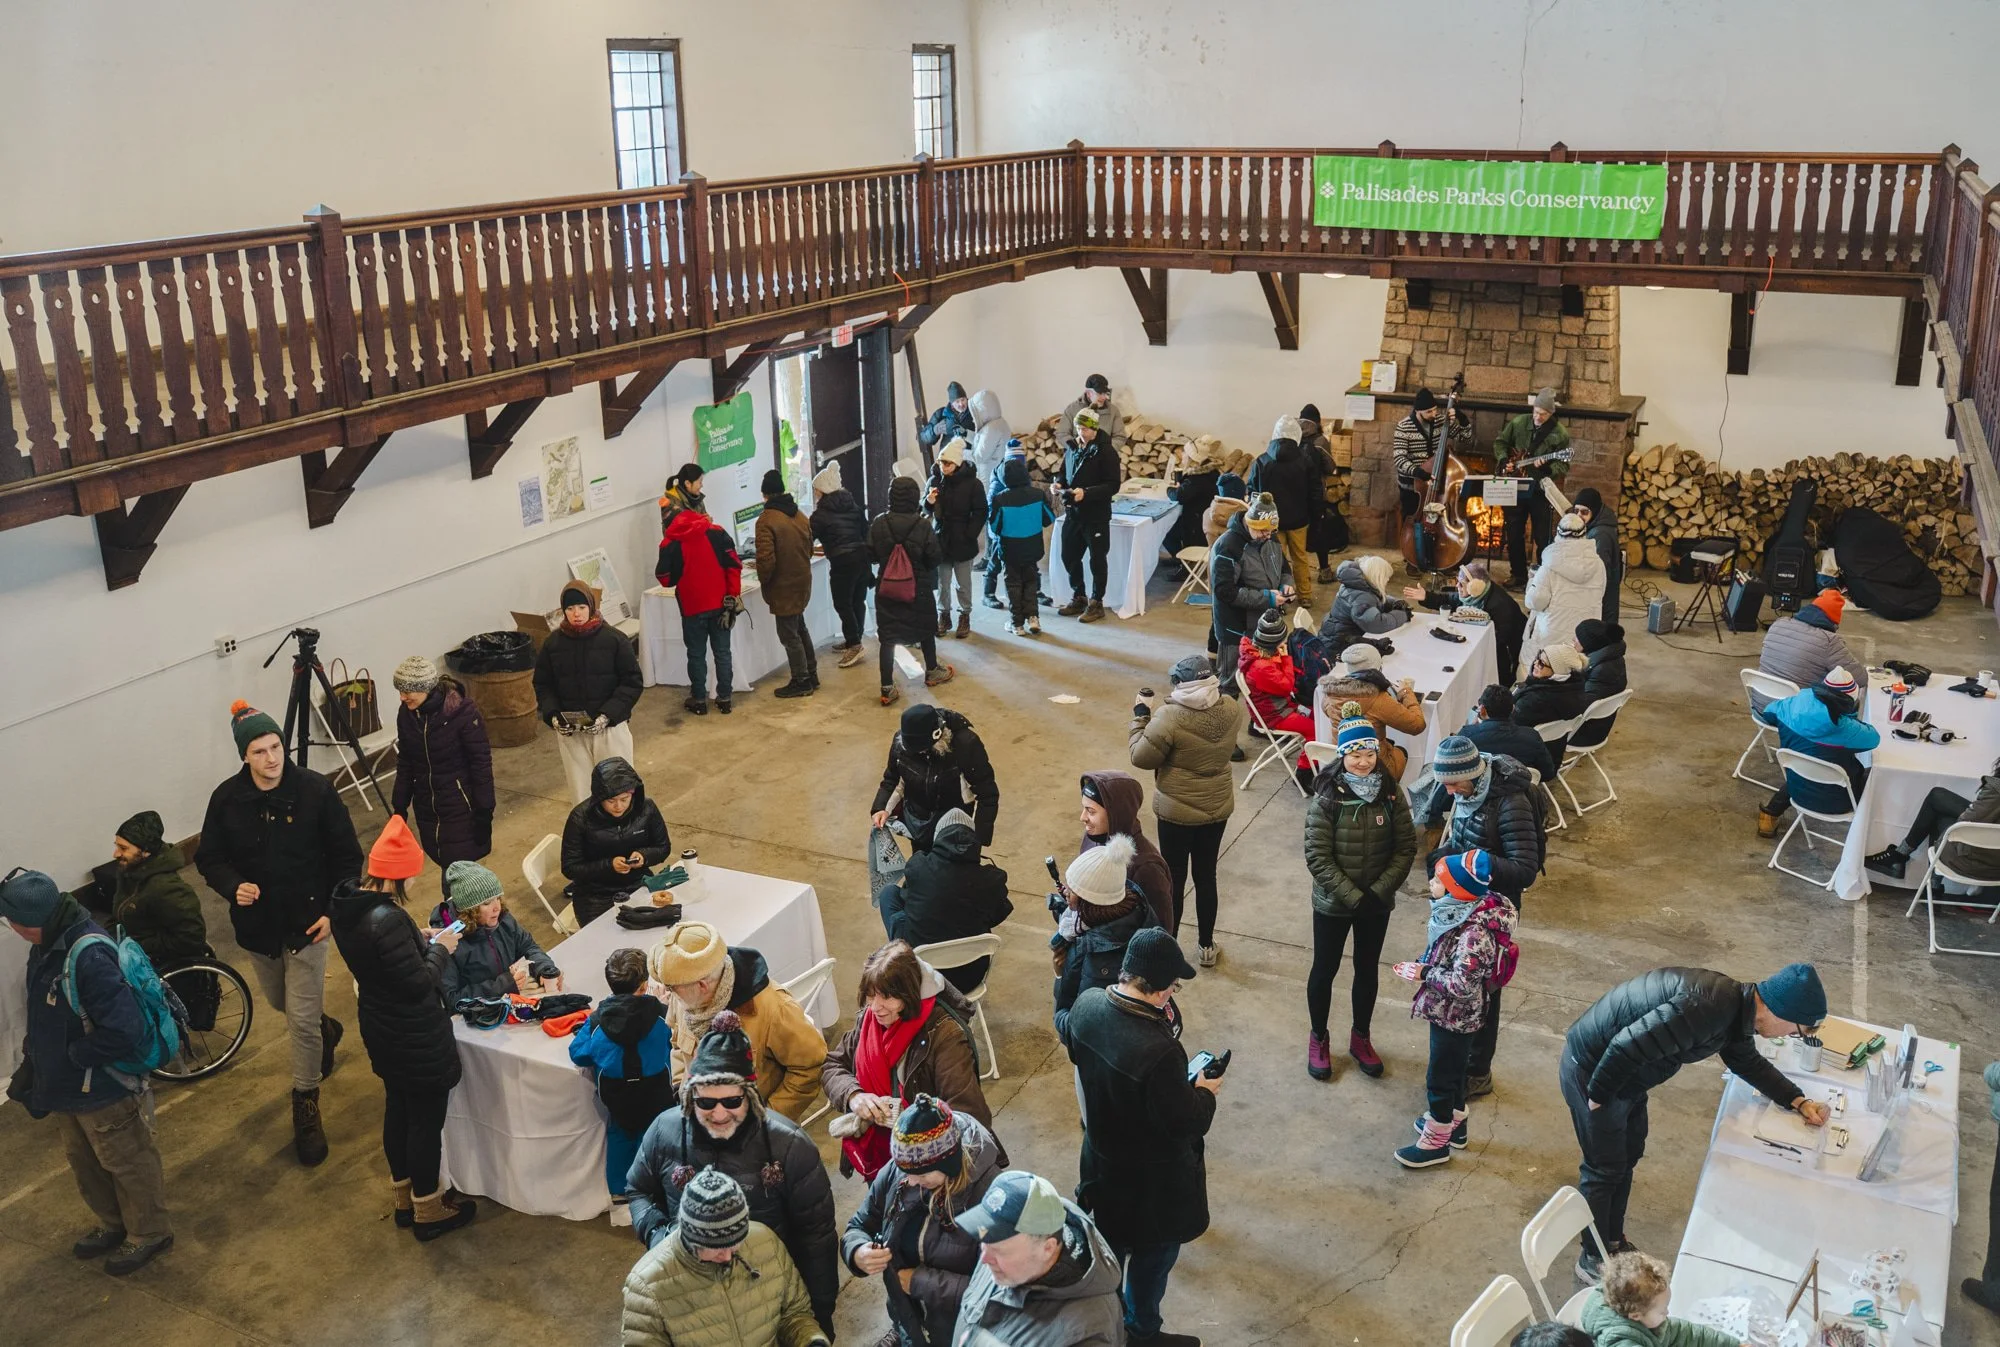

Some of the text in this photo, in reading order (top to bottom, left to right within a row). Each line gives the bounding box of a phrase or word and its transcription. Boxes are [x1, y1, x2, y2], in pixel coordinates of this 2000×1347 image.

[1341, 182, 1656, 214] Palisades Parks Conservancy
